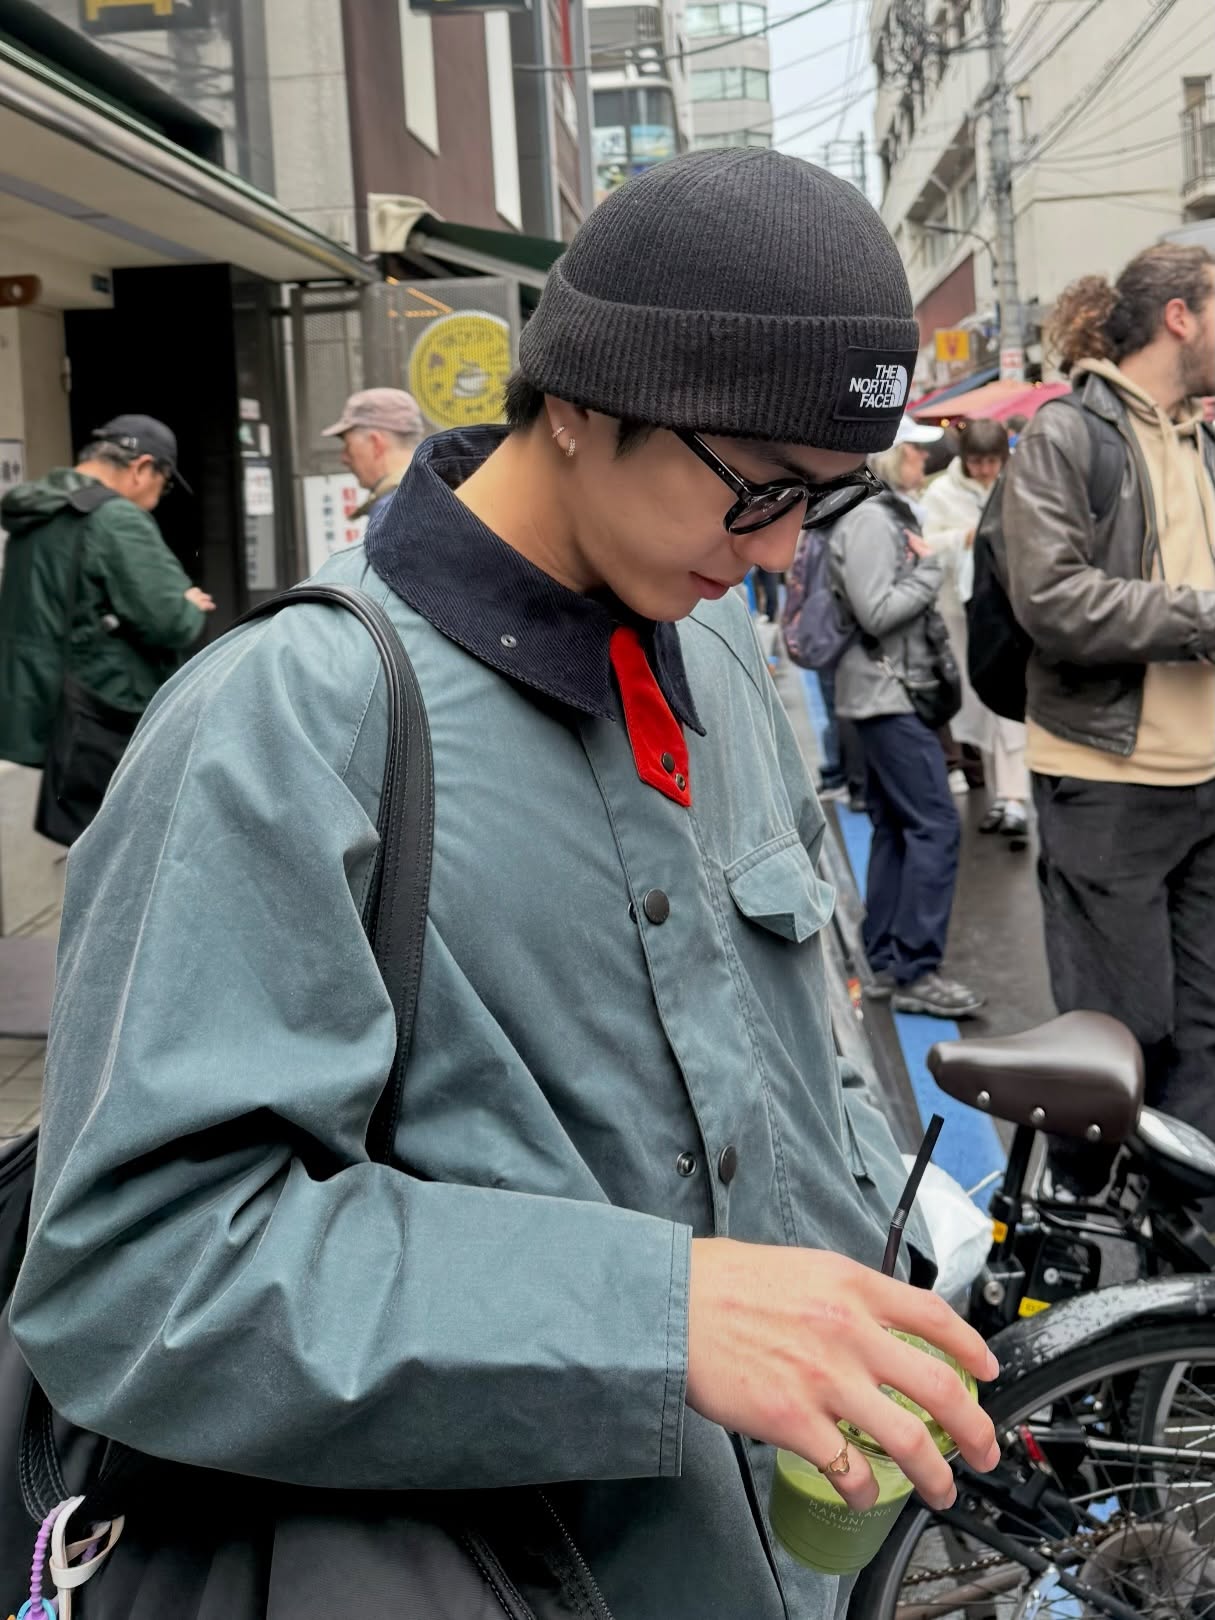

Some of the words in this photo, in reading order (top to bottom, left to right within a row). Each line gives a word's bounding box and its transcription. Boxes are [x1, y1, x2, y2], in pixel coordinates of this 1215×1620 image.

[875, 364, 898, 379] THE
[849, 377, 894, 393] NORTH
[860, 393, 891, 408] FACE
